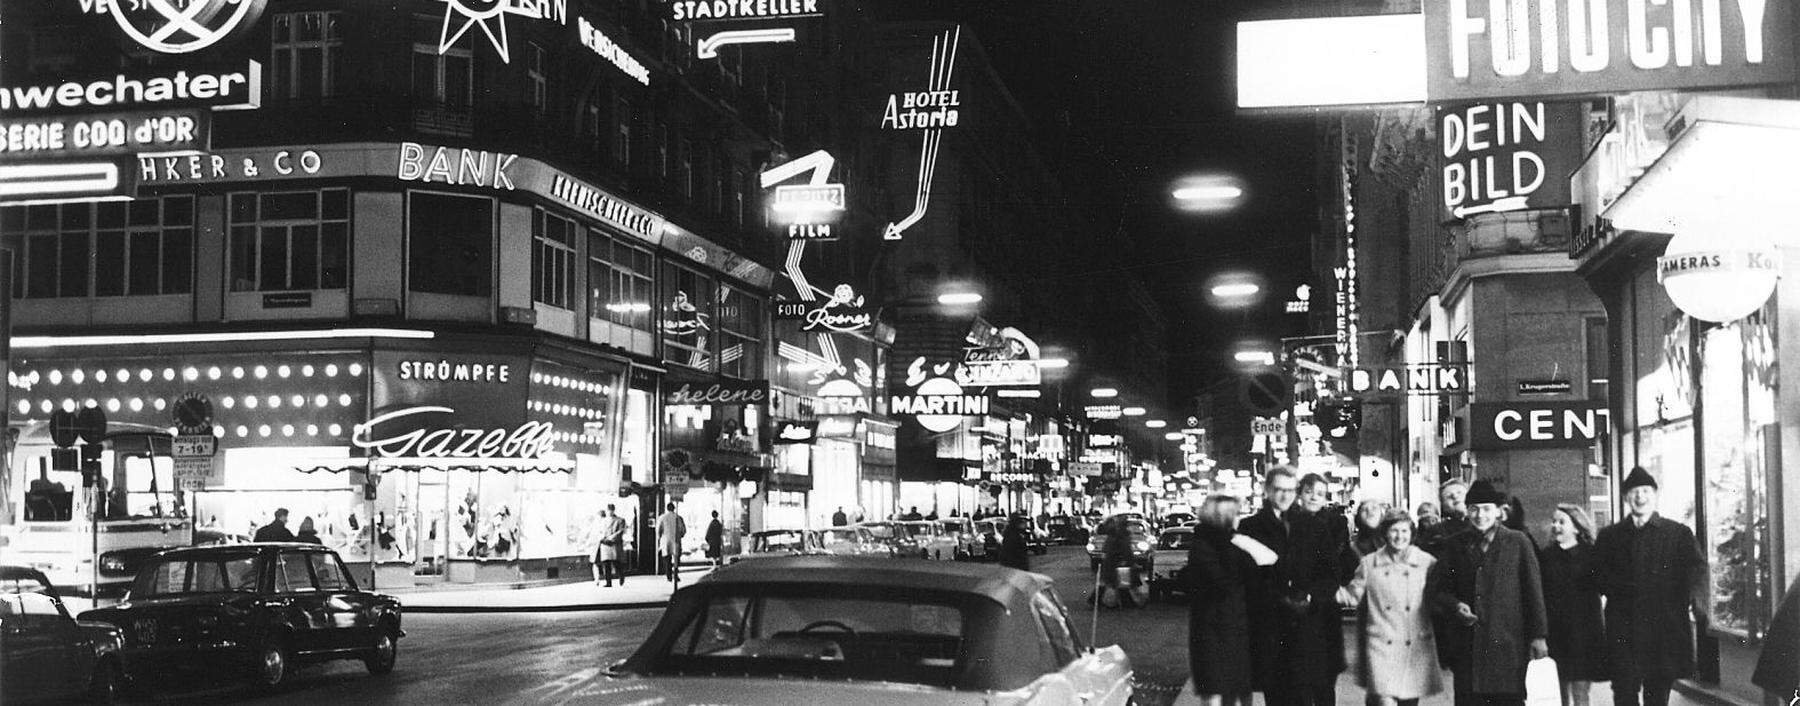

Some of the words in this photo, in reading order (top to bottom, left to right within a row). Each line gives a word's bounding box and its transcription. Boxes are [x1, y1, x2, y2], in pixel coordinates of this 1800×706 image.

[673, 0, 818, 20] STADTKELLER
[903, 90, 960, 109] HOTEL
[882, 94, 958, 130] Astoria
[74, 119, 125, 148] COQ
[1443, 102, 1545, 158] DEIN
[243, 158, 258, 177] &
[399, 142, 518, 191] BANK
[1444, 151, 1545, 208] BILD
[789, 224, 831, 238] FILM
[778, 303, 805, 317] FOTO
[399, 360, 510, 383] STRÜMPFE
[1352, 368, 1460, 392] BANK
[671, 383, 765, 404] helene
[891, 395, 989, 415] MARTINI
[352, 405, 556, 458] Gazelle
[1254, 421, 1282, 433] Ende
